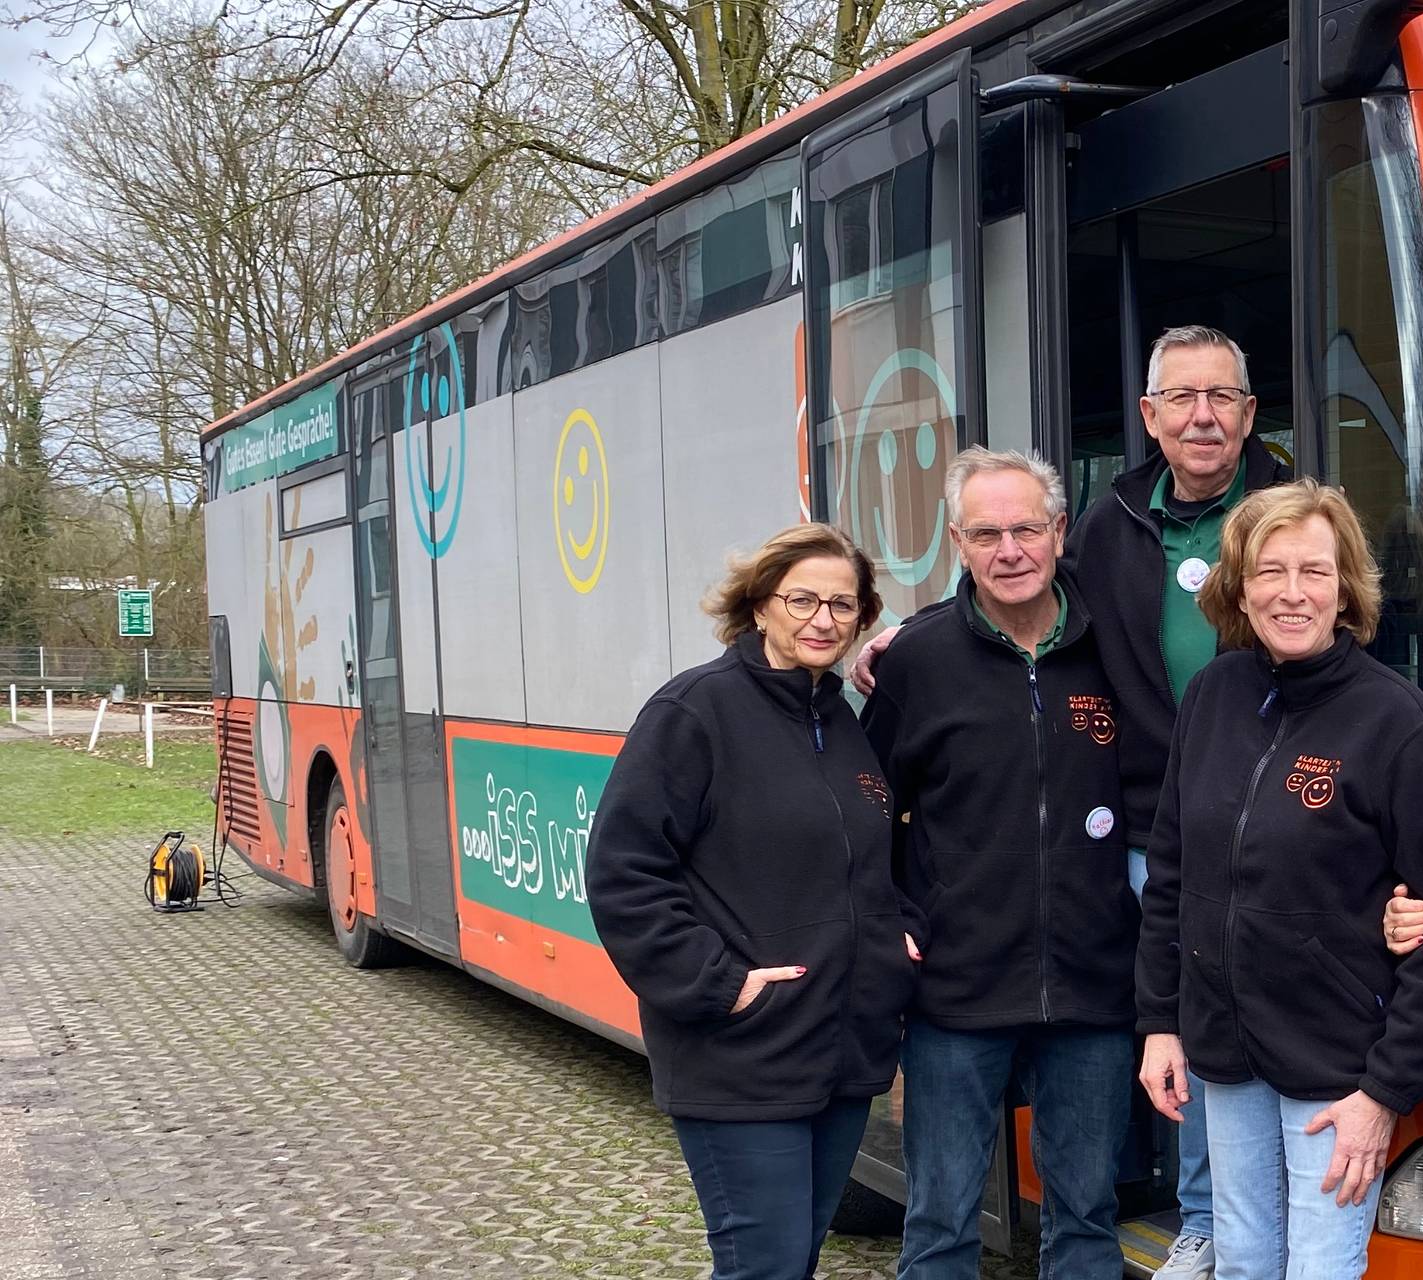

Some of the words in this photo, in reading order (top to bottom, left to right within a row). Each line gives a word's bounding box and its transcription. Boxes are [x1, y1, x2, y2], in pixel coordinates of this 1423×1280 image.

[226, 446, 245, 476] Gutes
[245, 430, 267, 468] Essen!
[268, 427, 286, 460] Gute
[287, 401, 334, 458] Gespräche!
